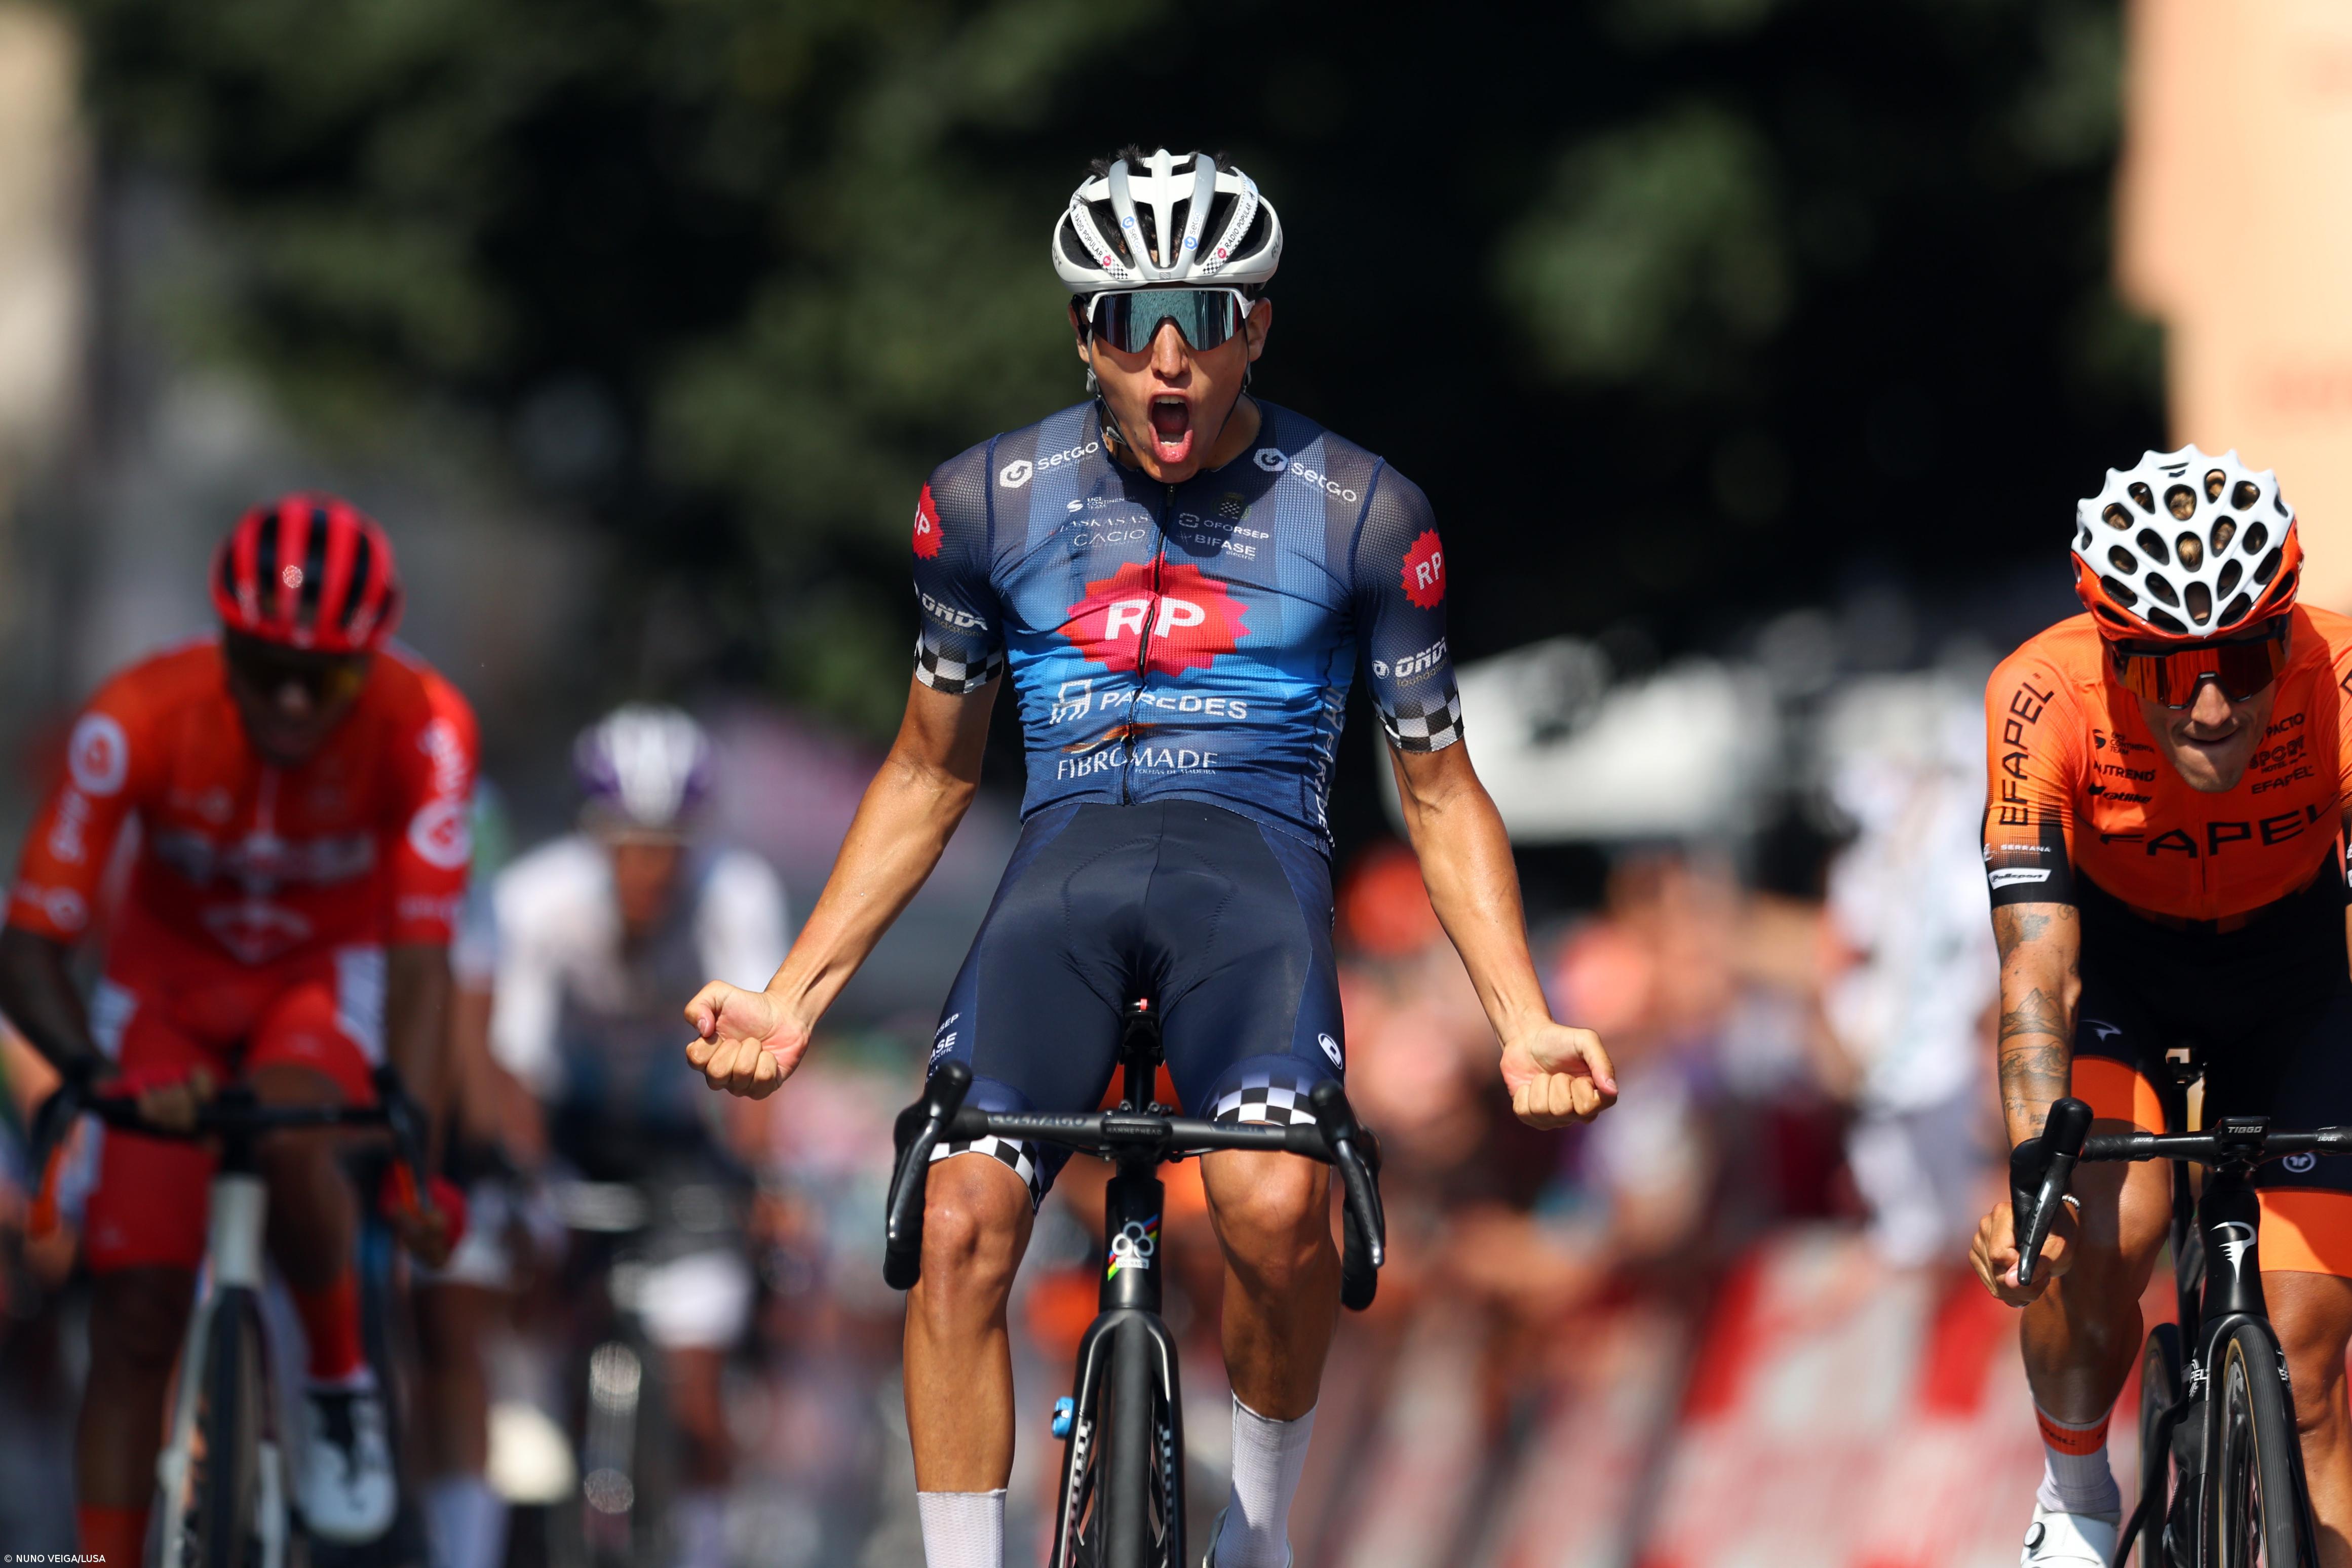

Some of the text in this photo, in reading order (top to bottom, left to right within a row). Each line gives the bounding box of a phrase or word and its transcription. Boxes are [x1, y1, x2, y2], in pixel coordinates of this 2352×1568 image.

[1237, 203, 1252, 229] POPULAR
[1082, 230, 1102, 257] POPULAR
[1204, 520, 1269, 539] OFORSEP
[1194, 534, 1256, 557] BIFASE
[1226, 551, 1255, 562] electric
[1415, 552, 1441, 590] RP
[922, 608, 984, 637] oundations
[1105, 597, 1206, 640] RP
[1100, 690, 1248, 719] PAREDES
[1058, 748, 1218, 780] FIBROMADE
[1999, 682, 2055, 826] EFAPEL
[2100, 804, 2329, 858] FAPEL
[2001, 844, 2051, 852] SERRANA
[929, 1032, 957, 1064] ASE
